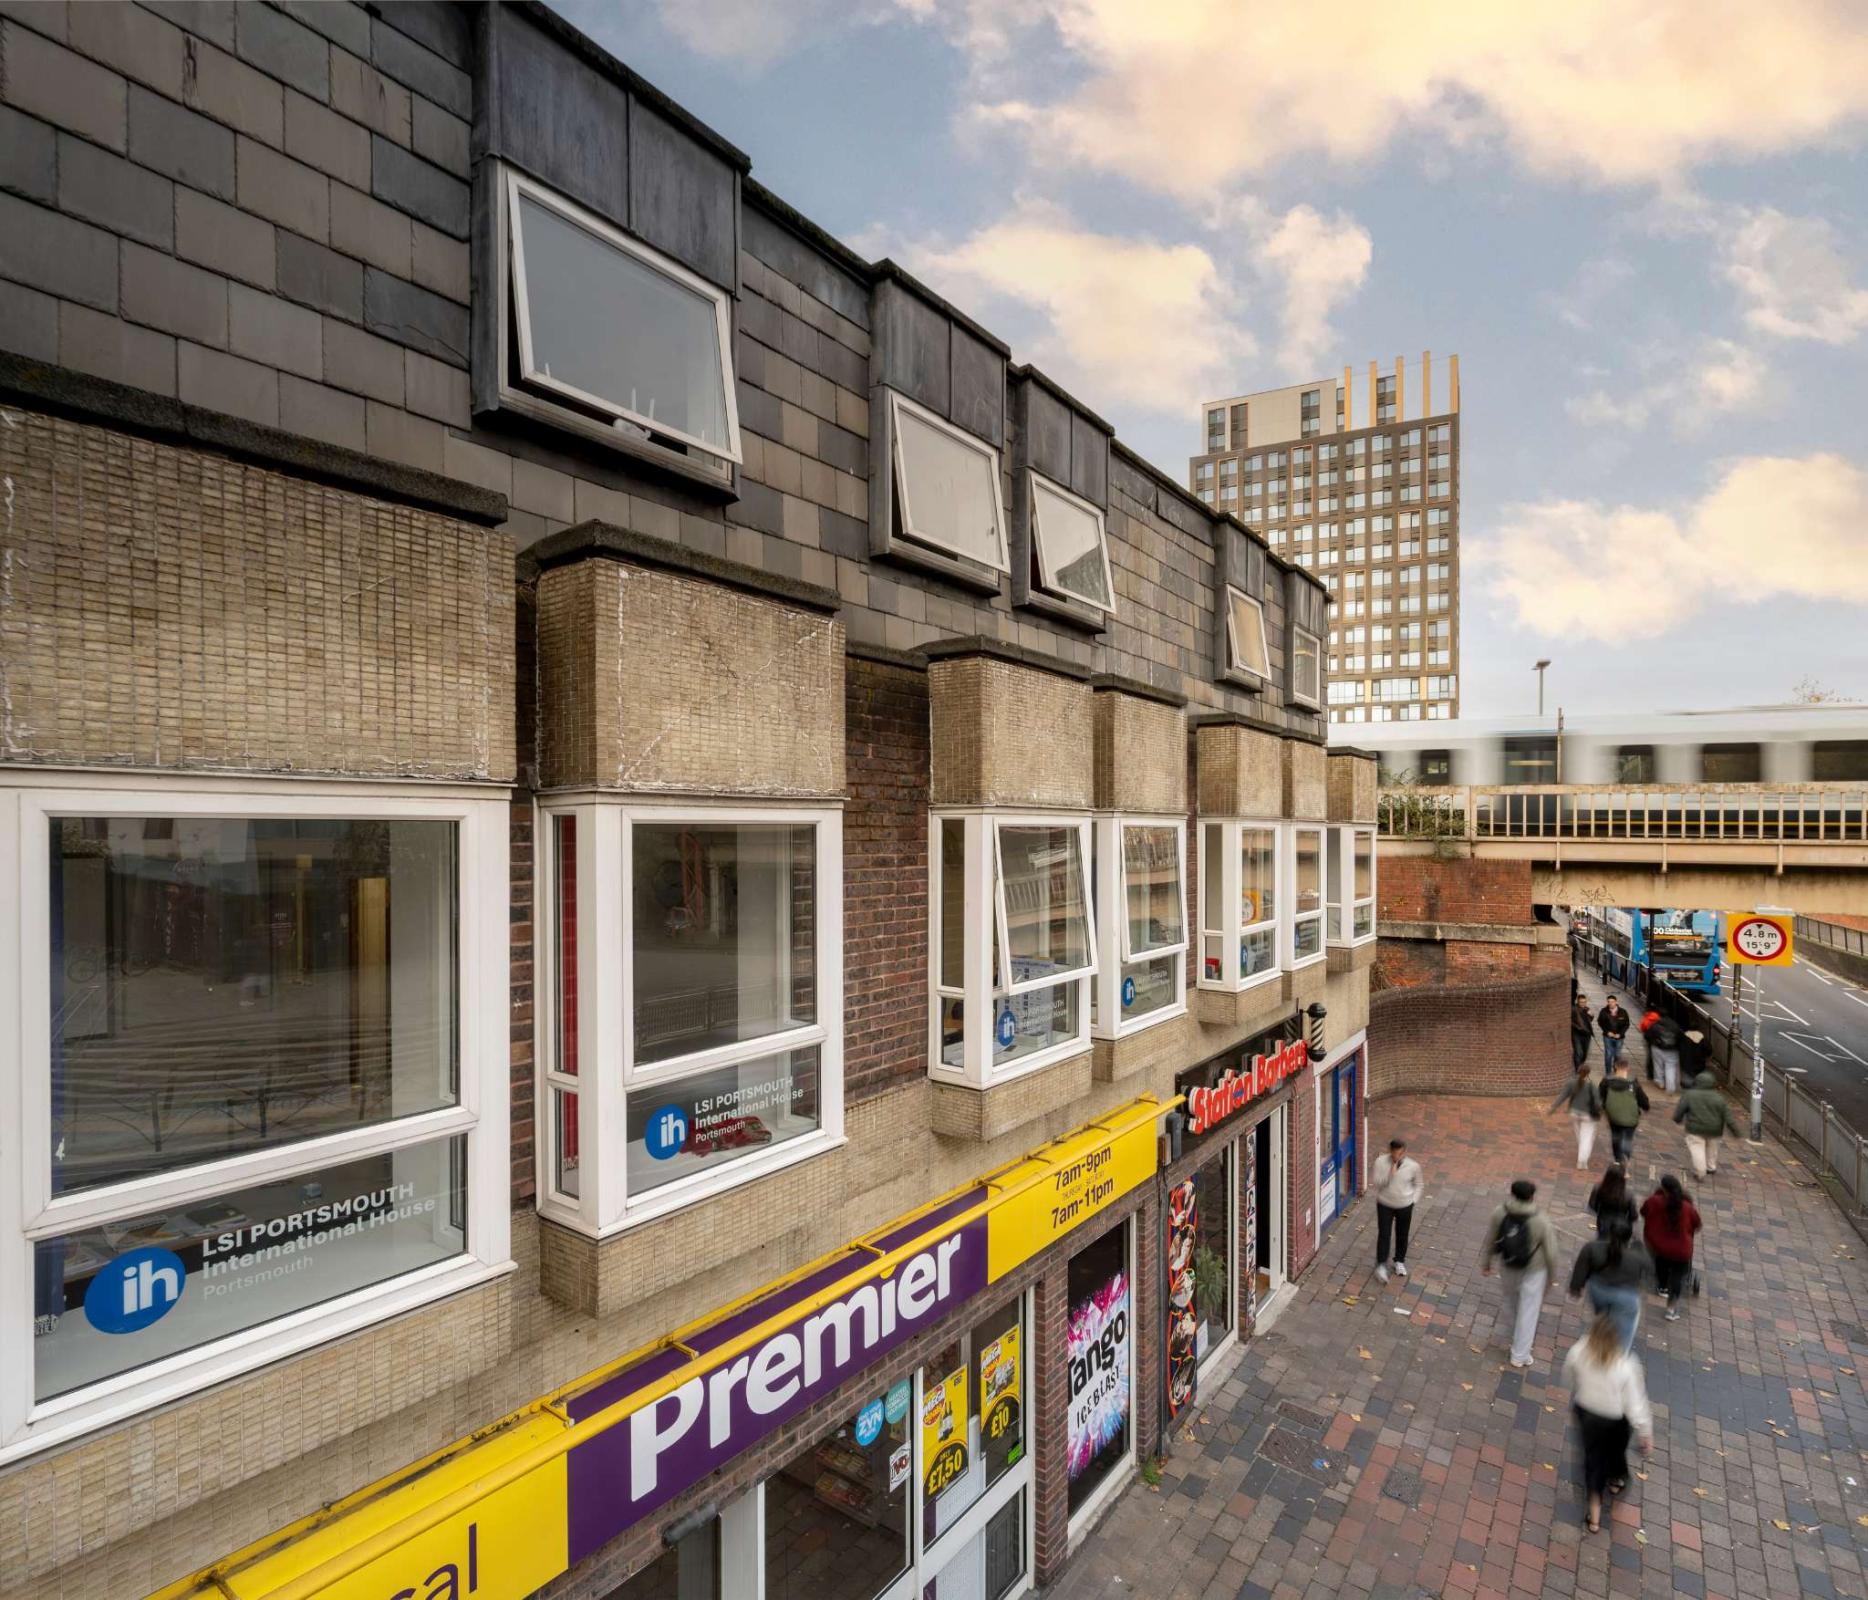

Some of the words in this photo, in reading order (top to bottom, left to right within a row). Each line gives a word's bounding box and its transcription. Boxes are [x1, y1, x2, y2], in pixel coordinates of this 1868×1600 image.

[1743, 929, 1765, 939] 4.8
[1003, 1017, 1015, 1039] ih
[694, 1099, 713, 1115] LSI
[716, 1076, 794, 1109] PORTSMOUTH
[695, 1097, 769, 1130] International
[771, 1088, 804, 1106] House
[1188, 1068, 1253, 1136] Station
[1252, 1039, 1308, 1096] Barbers
[660, 1112, 686, 1148] ih
[695, 1119, 746, 1144] Portsmouth
[202, 1231, 242, 1258] LSI
[250, 1181, 415, 1244] PORTSMOUTH
[202, 1217, 364, 1280] International
[368, 1198, 435, 1229] House
[123, 1260, 179, 1316] ih
[203, 1255, 314, 1301] Portsmouth
[630, 1233, 962, 1502] Premier
[1068, 1310, 1127, 1406] Tango
[858, 1411, 881, 1437] ZYN
[991, 1406, 1010, 1438] £10
[928, 1449, 963, 1496] £7.50
[390, 1522, 478, 1600] al
